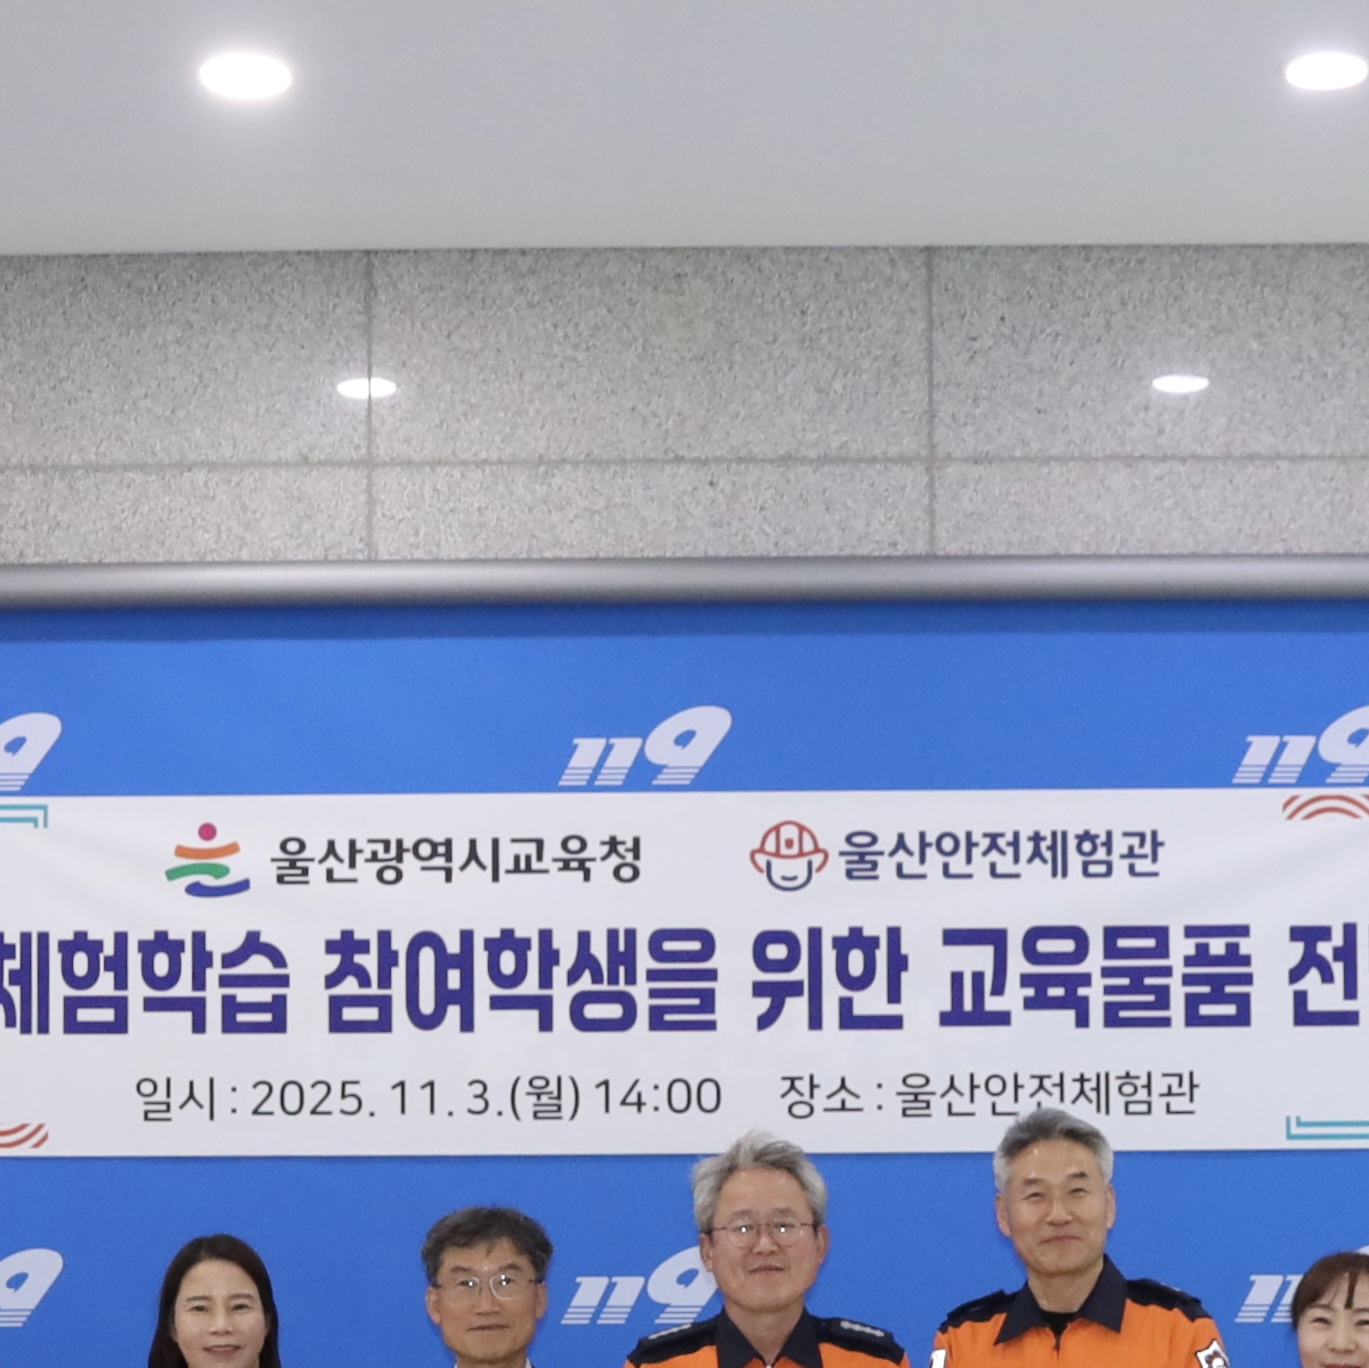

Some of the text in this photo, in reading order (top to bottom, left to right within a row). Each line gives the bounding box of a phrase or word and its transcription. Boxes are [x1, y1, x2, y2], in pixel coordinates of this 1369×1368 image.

[558, 704, 734, 786] 119
[270, 835, 641, 886] 울산광역시교육청
[838, 828, 1165, 881] 울산안전체험관
[324, 928, 719, 1034] 참여학생을
[752, 926, 908, 1031] 위한
[938, 923, 1253, 1029] 교육물품
[252, 1079, 375, 1118] 2025.
[596, 1077, 722, 1114] 14:00
[895, 1070, 1200, 1119] 울산안전체험관
[560, 1246, 718, 1325] 119
